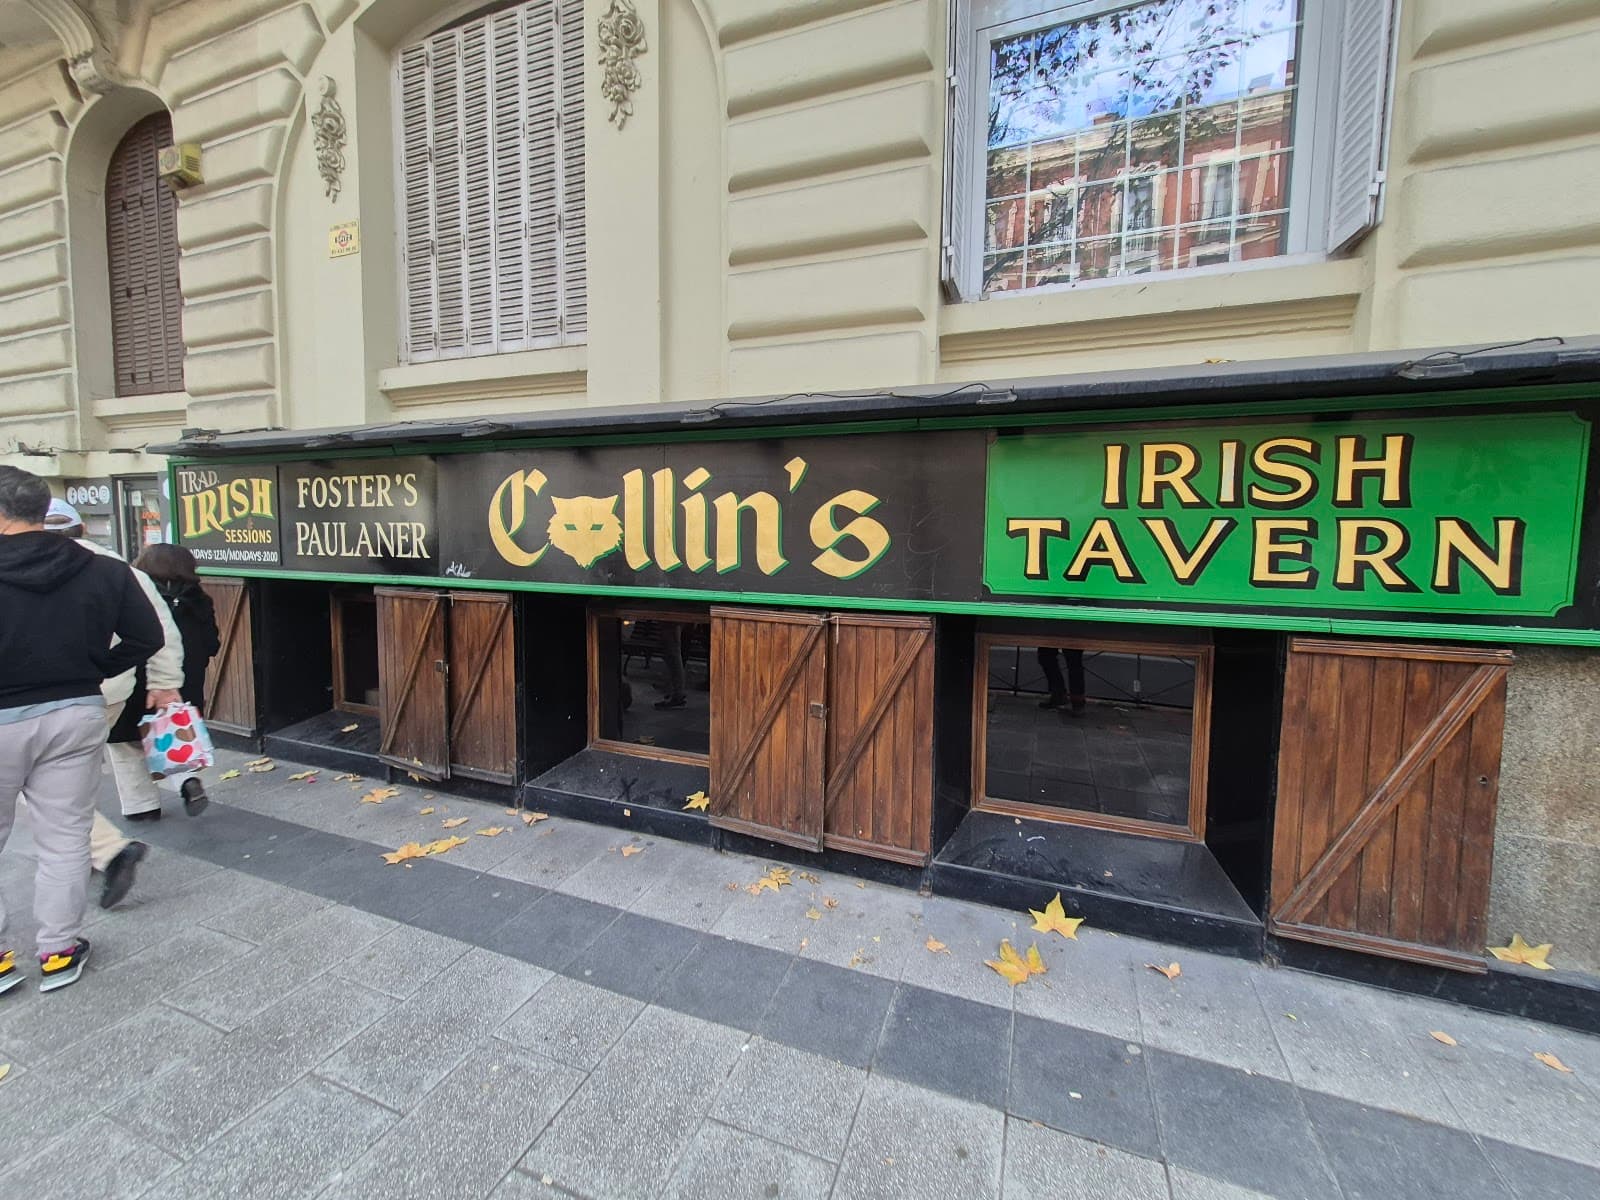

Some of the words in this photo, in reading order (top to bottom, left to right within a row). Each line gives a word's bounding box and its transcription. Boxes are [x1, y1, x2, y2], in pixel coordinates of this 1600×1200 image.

[297, 473, 418, 508] FOSTER'S
[1102, 433, 1411, 509] IRISH
[181, 478, 275, 538] IRISH
[225, 529, 272, 544] SESSIONS
[488, 456, 892, 580] Cllin's
[296, 522, 431, 559] PAULANER
[1008, 516, 1526, 595] TAVERN
